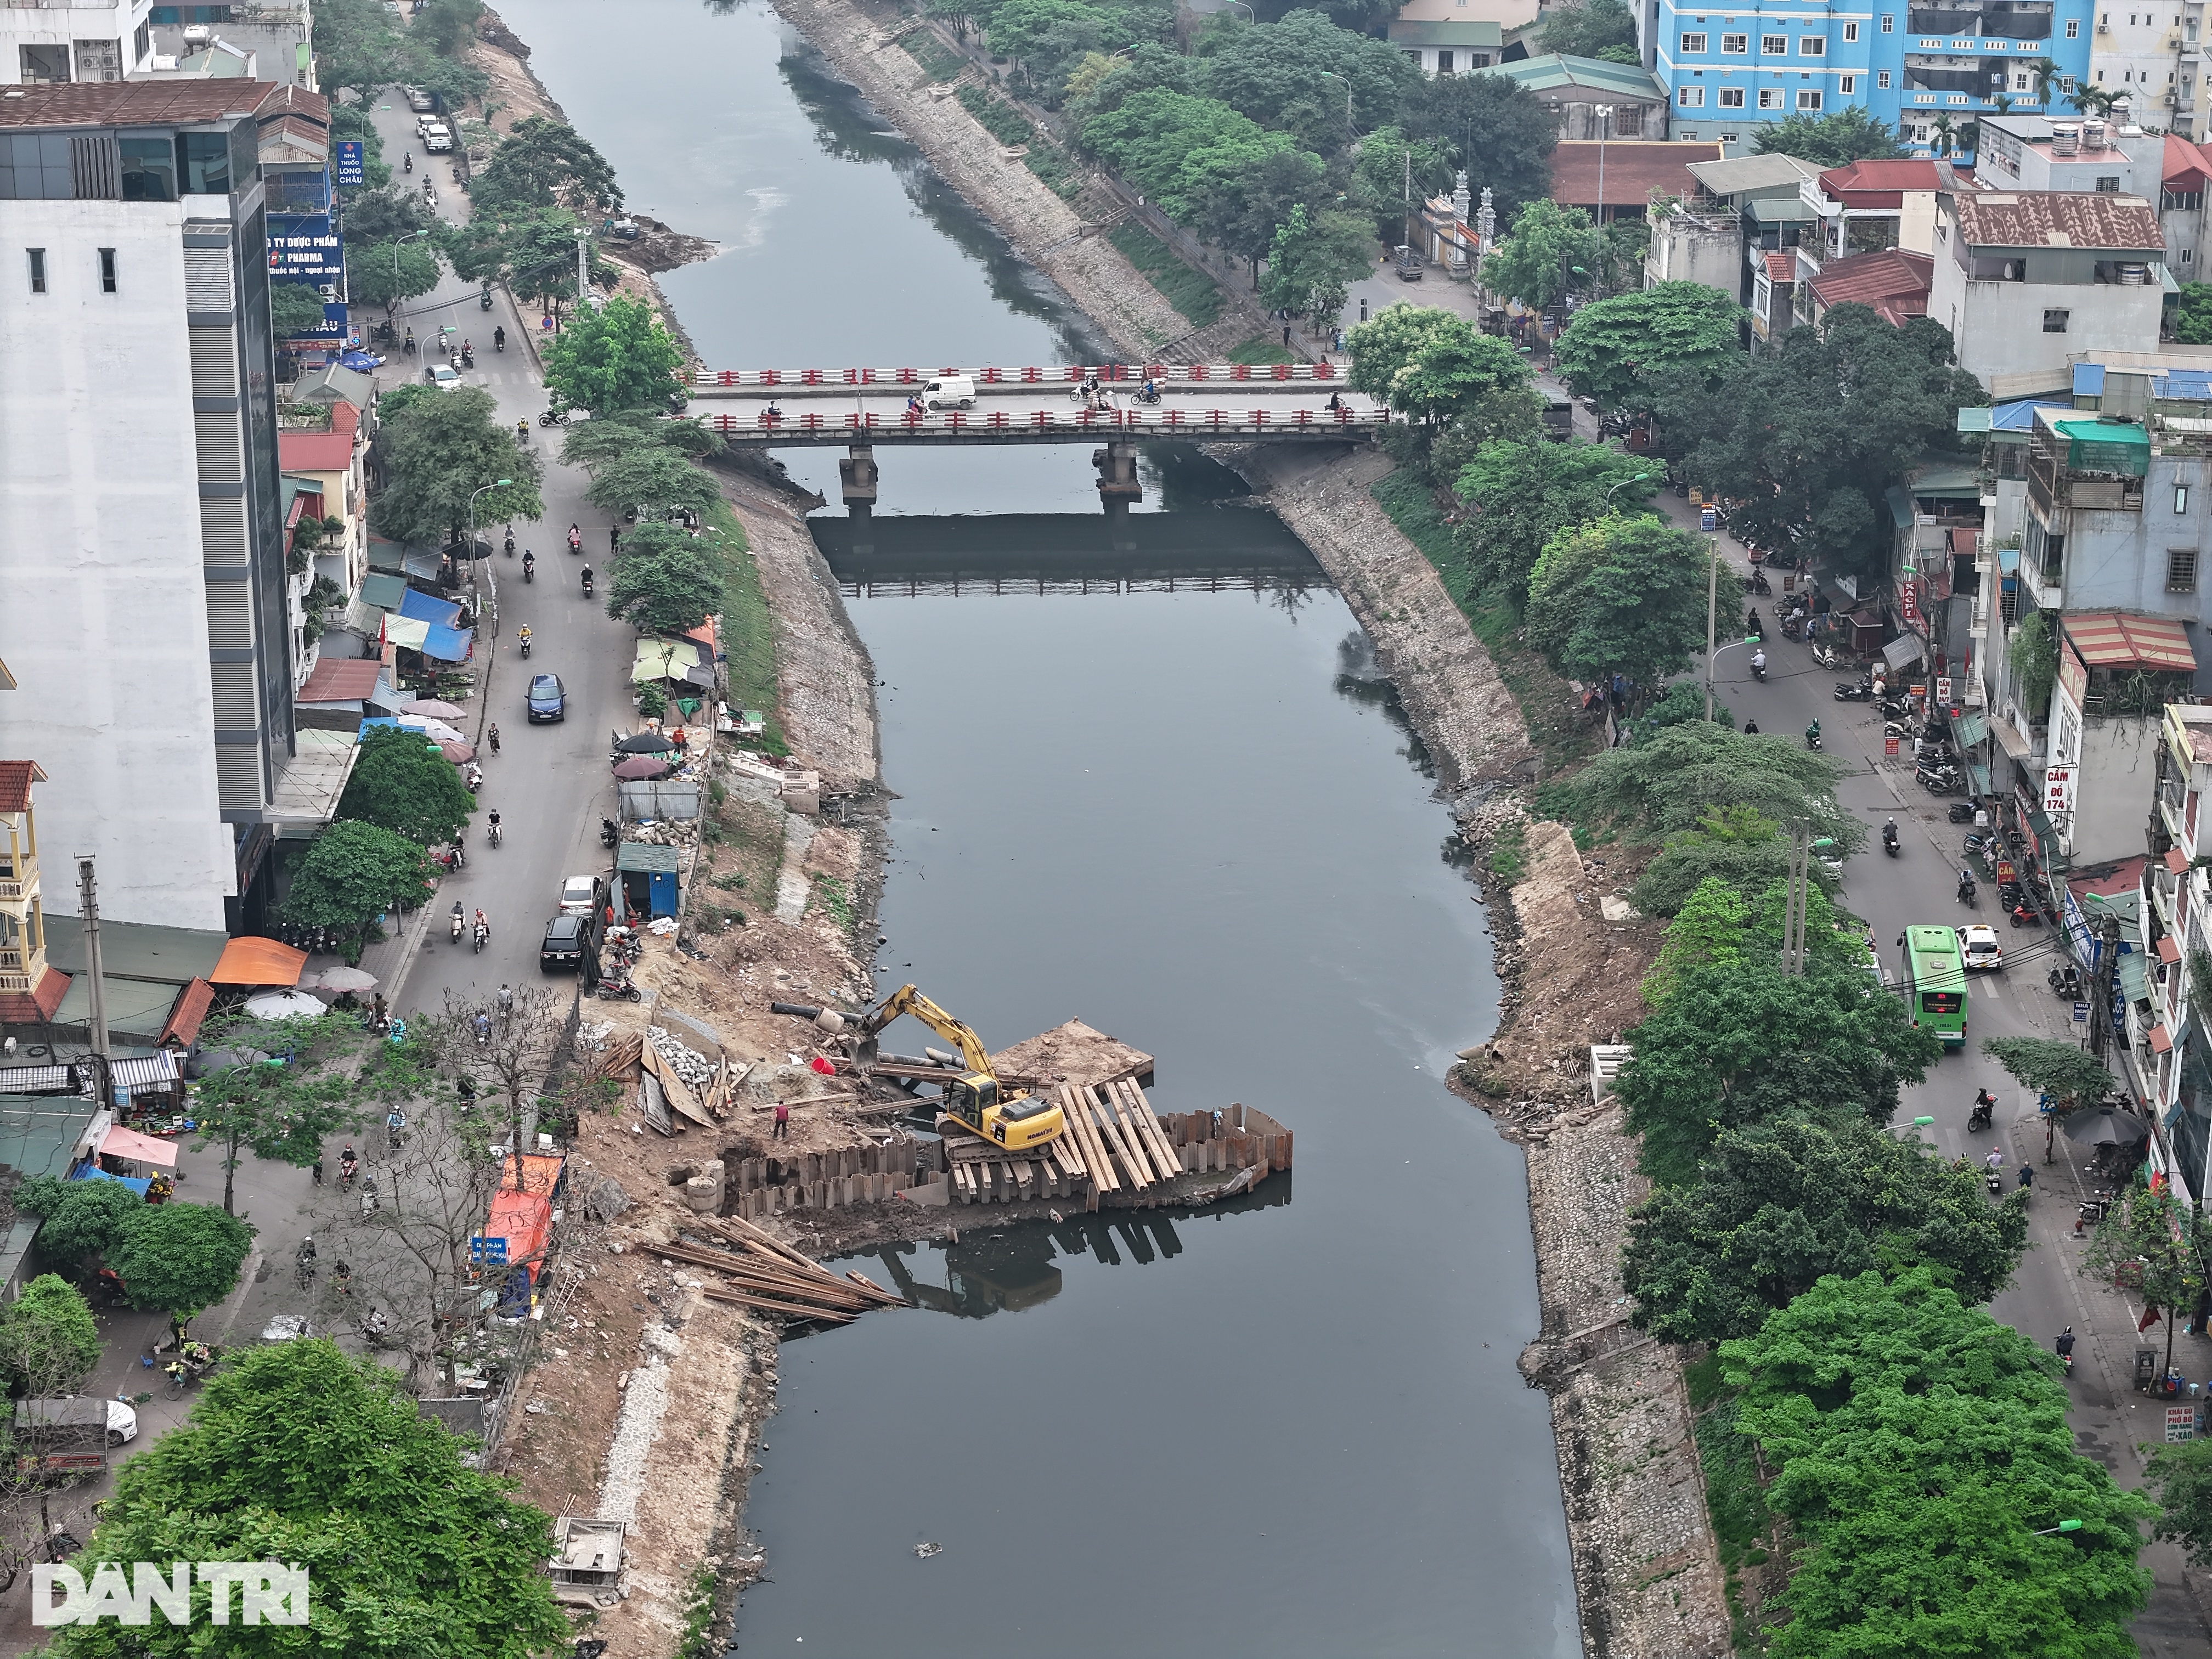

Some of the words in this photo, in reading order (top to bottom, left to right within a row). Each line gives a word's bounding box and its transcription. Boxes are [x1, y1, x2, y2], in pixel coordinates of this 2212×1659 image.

[339, 175, 362, 183] CHÂU
[274, 238, 285, 247] TY
[287, 236, 311, 248] DƯỢC
[287, 253, 323, 262] PHARMA
[289, 267, 299, 275] nội
[305, 267, 323, 275] ngoại
[324, 266, 340, 274] nhập
[1905, 583, 1915, 617] KACHI
[2047, 768, 2068, 782] CẦM
[2051, 783, 2063, 797] ĐỒ
[2046, 800, 2064, 809] 174
[915, 1012, 936, 1031] KOMATSU
[1027, 1127, 1053, 1140] KOMATSU
[2168, 1415, 2182, 1424] PHỞ
[2183, 1415, 2192, 1423] BÒ
[2178, 1430, 2192, 1440] XÀO
